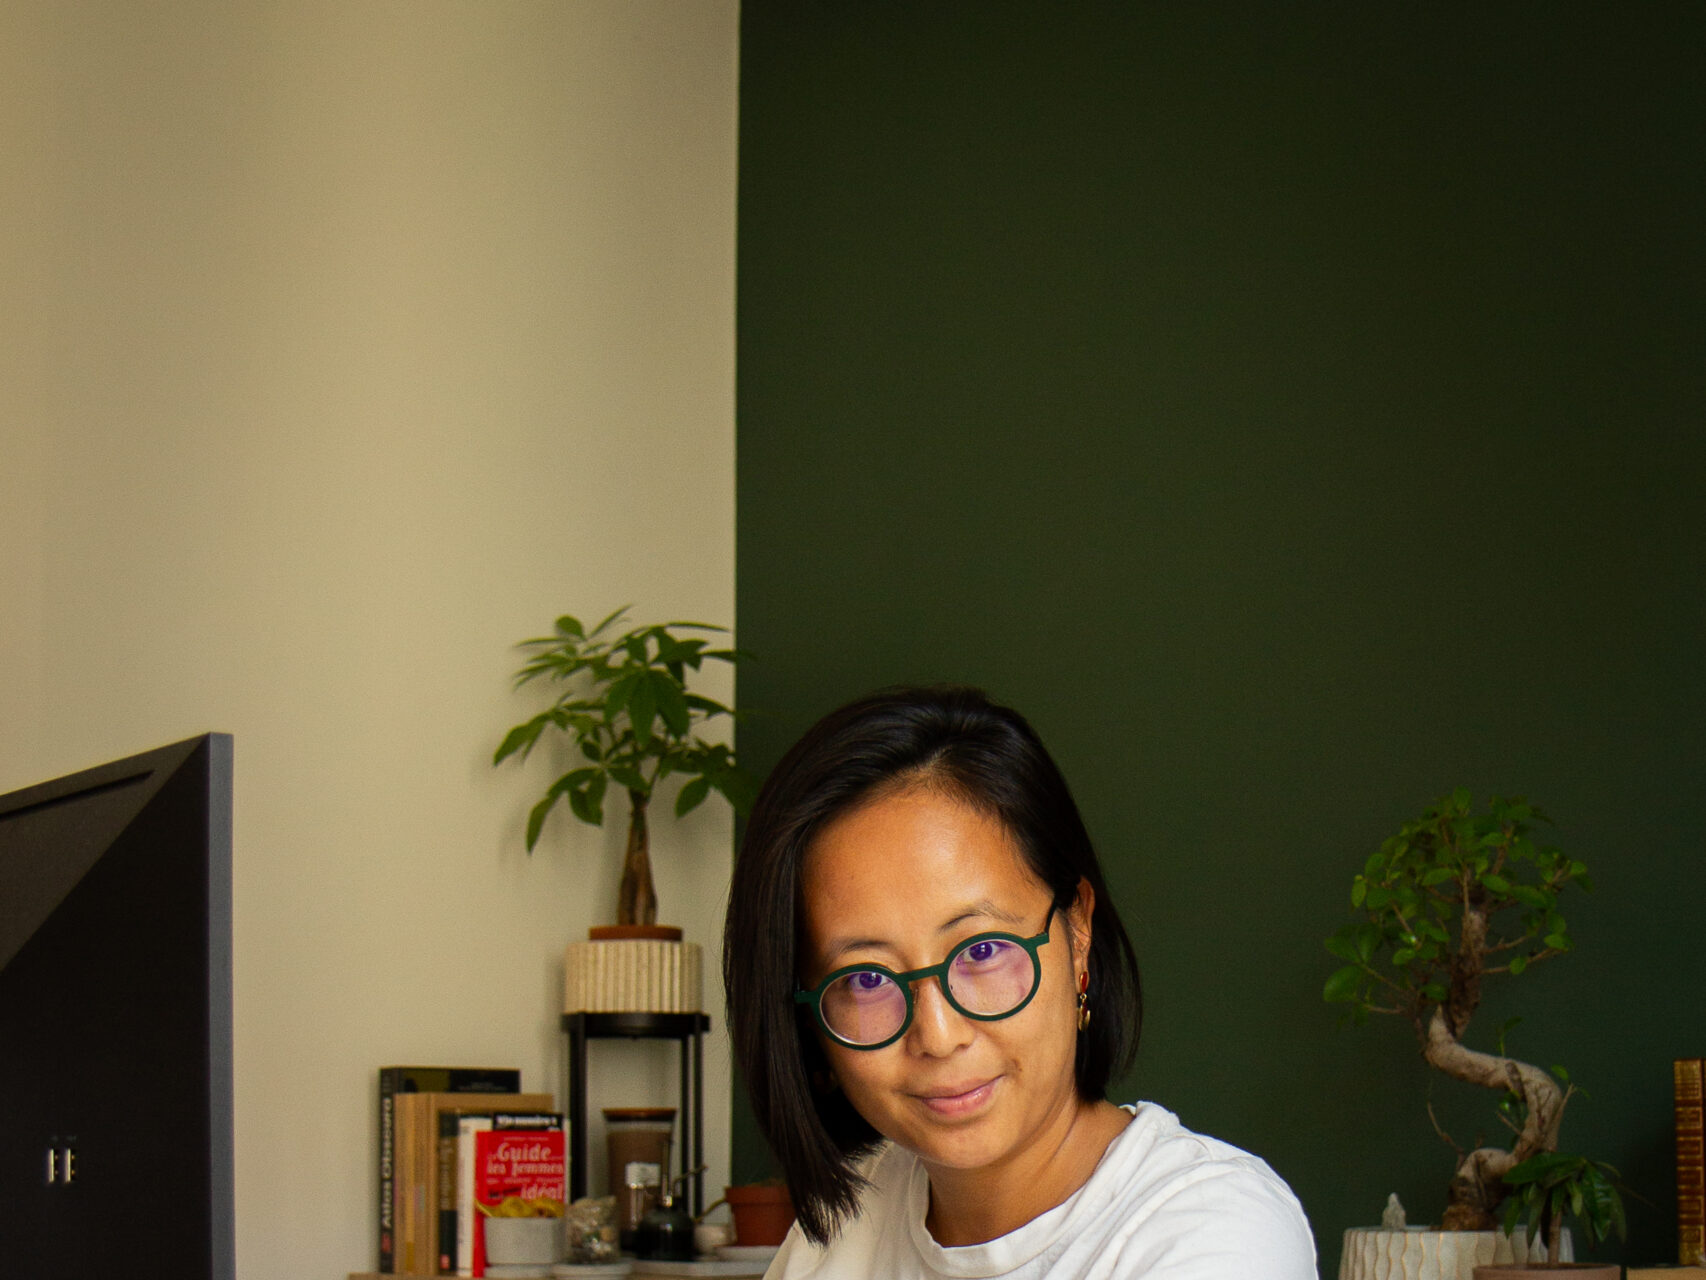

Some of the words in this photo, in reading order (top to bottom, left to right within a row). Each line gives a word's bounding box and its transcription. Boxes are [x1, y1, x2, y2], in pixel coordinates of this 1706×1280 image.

[382, 1097, 392, 1179] Obscura
[497, 1142, 551, 1161] Guide
[382, 1182, 392, 1228] Atlas
[520, 1183, 563, 1200] idéal
